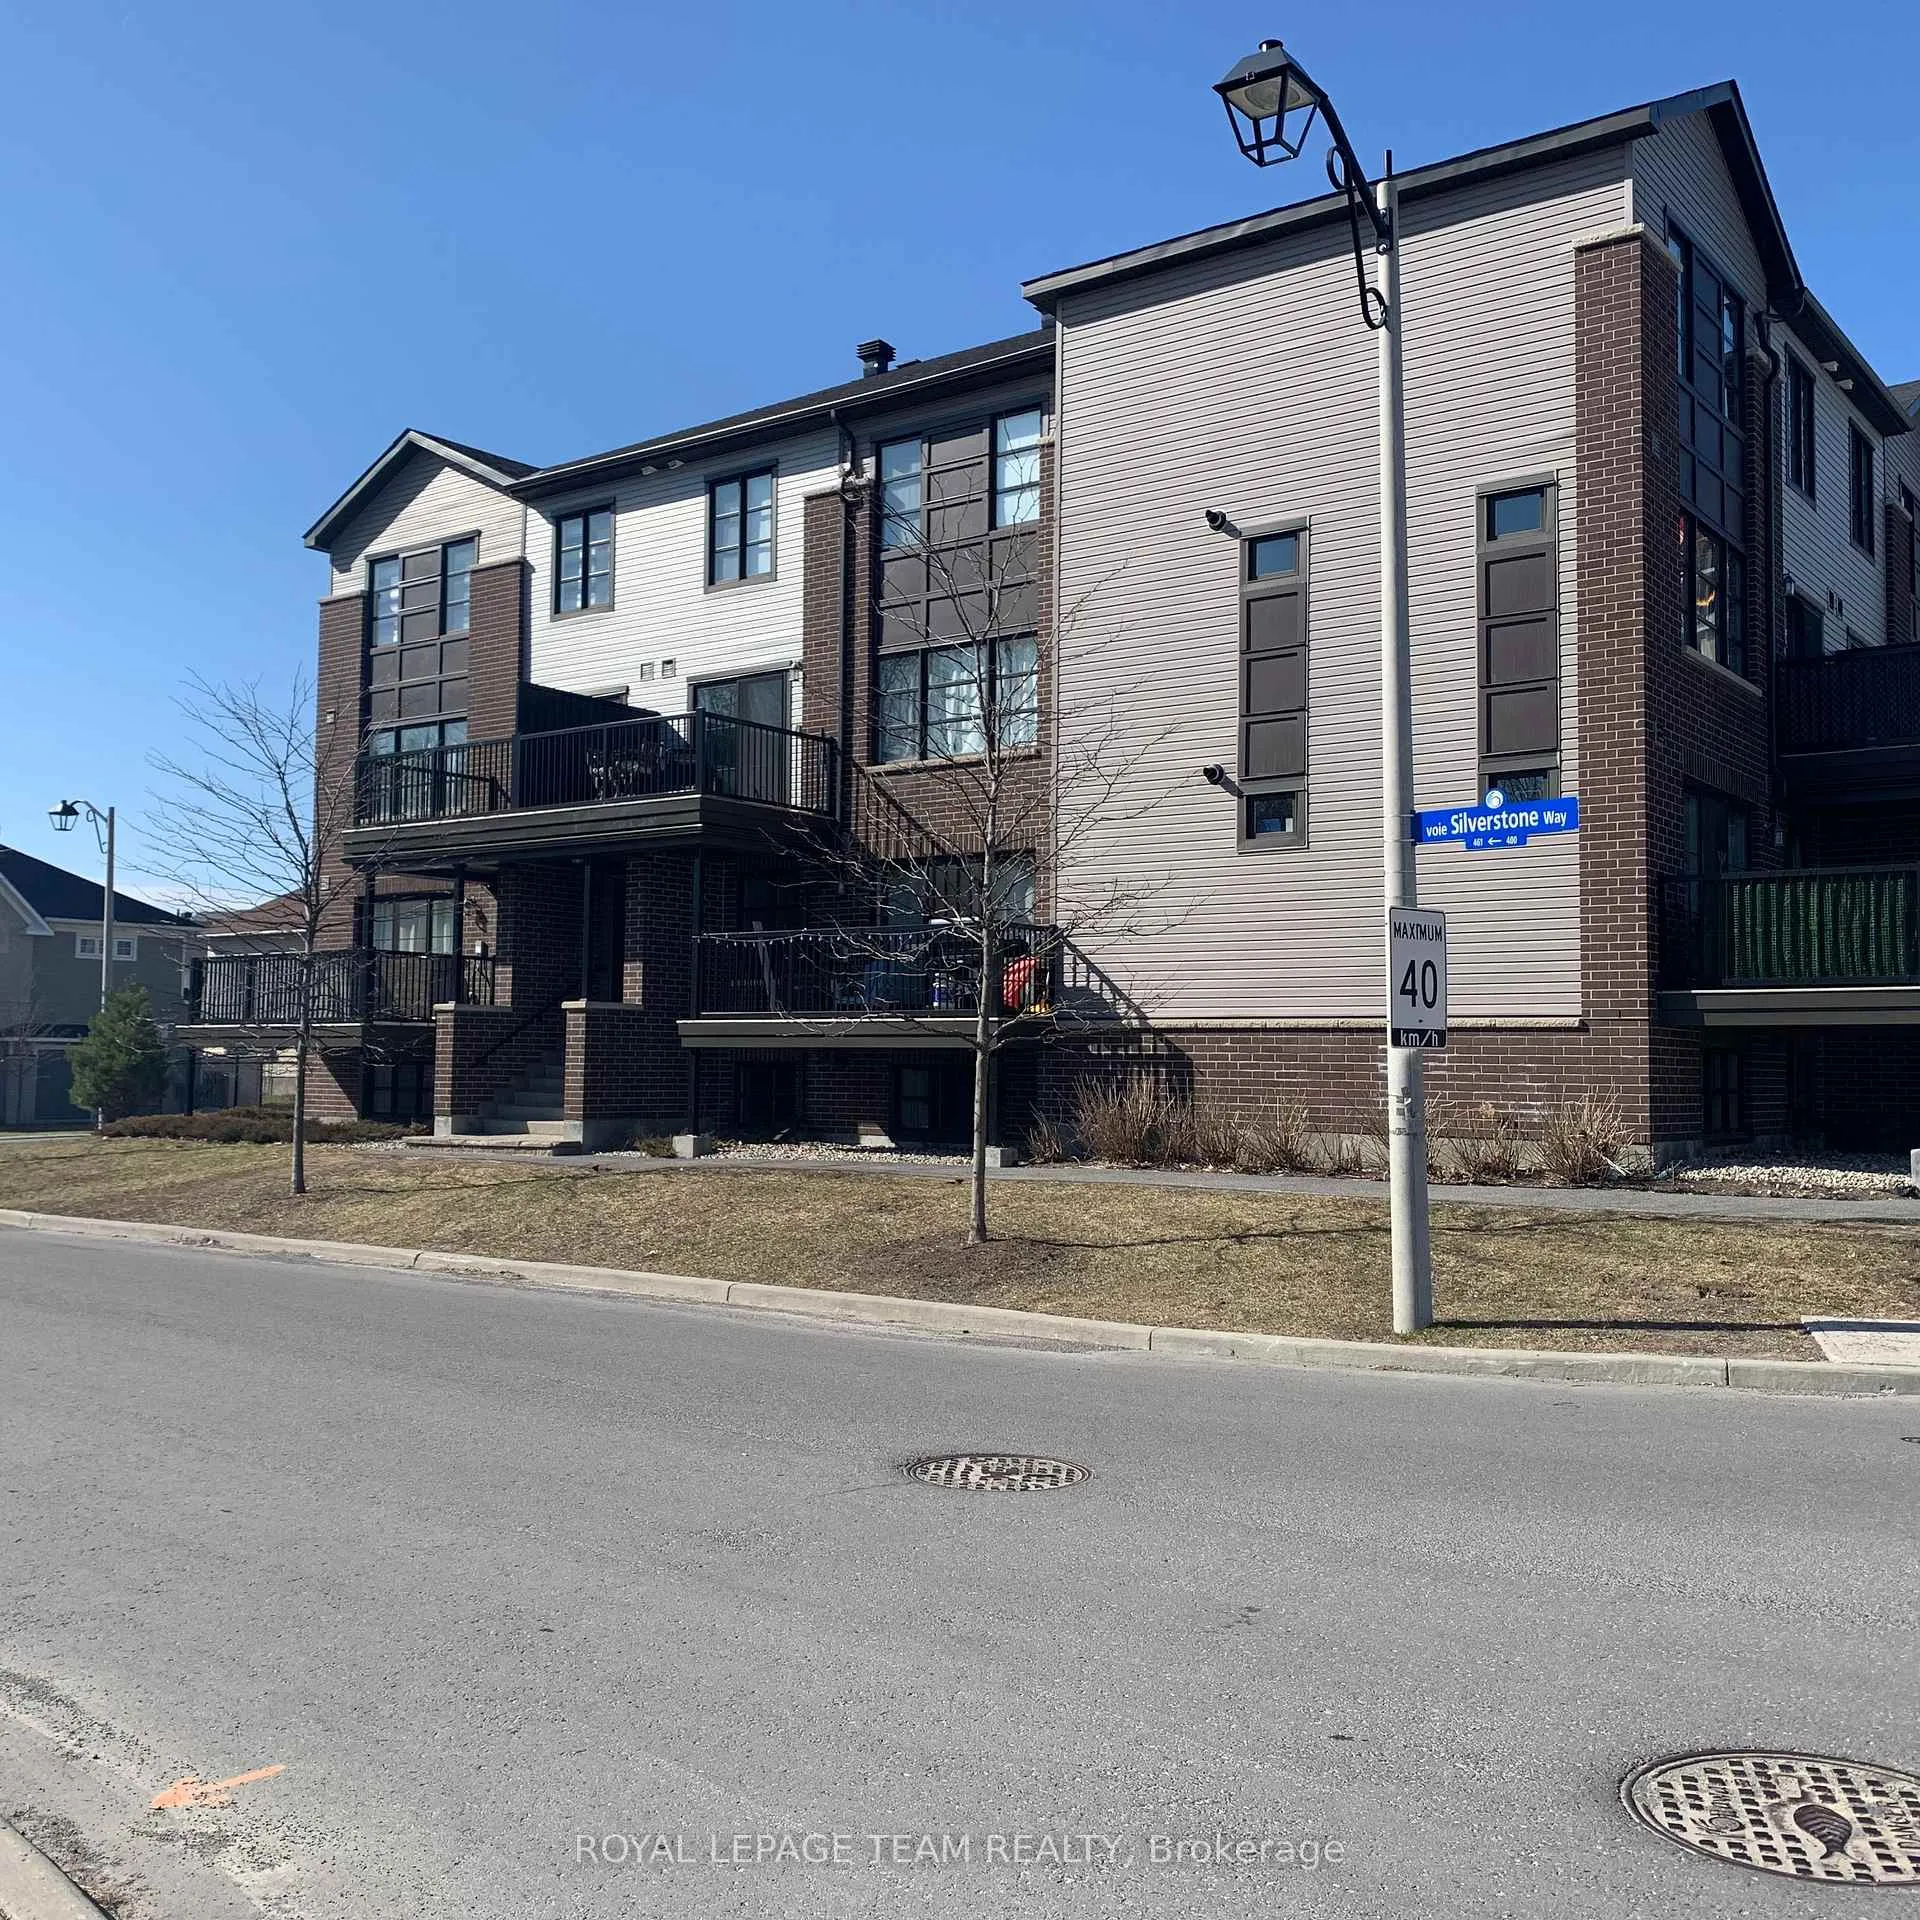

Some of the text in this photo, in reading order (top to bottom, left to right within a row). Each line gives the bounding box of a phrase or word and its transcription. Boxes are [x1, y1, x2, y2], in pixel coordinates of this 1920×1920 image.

[1425, 810, 1567, 838] voie Silverstone Way
[1506, 835, 1518, 845] 400
[1393, 921, 1443, 942] MAXIMUM
[1400, 959, 1438, 1009] 40
[1400, 1030, 1439, 1047] km/h
